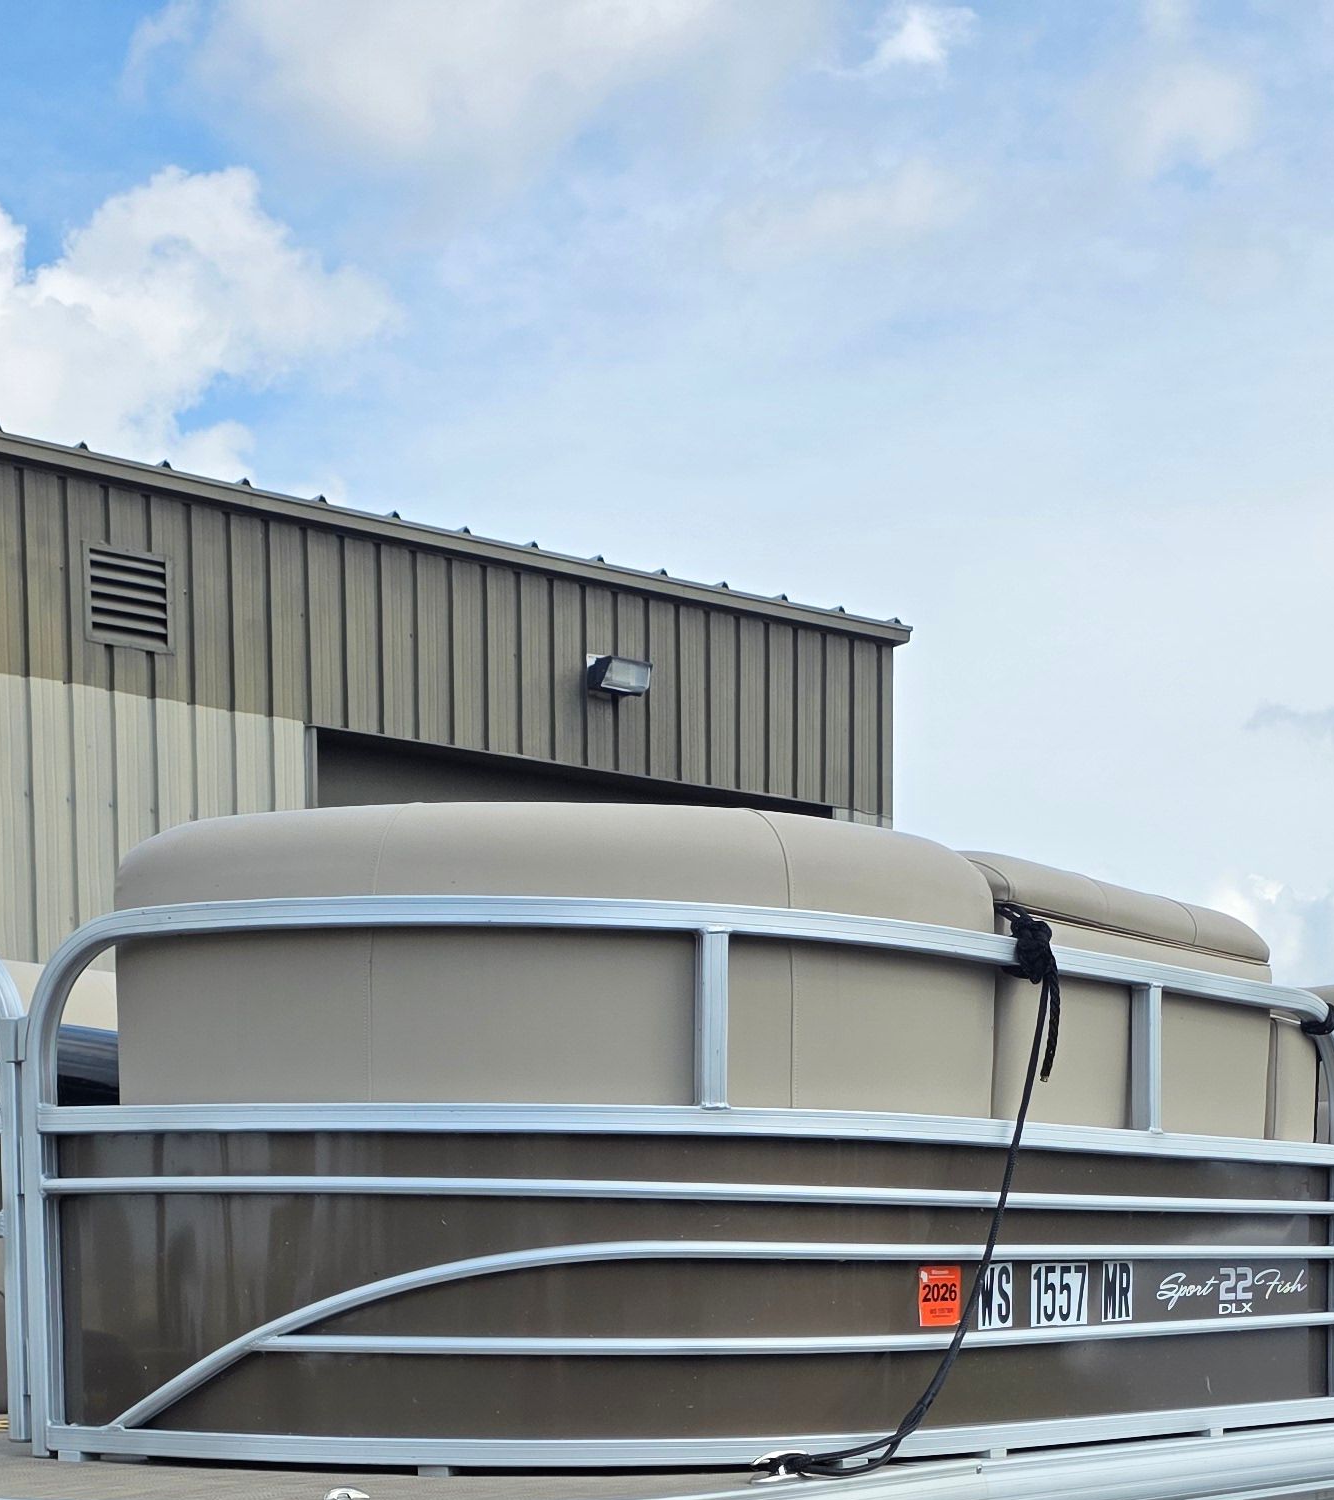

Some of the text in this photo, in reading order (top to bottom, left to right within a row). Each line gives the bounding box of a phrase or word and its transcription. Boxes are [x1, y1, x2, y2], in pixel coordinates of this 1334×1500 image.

[921, 1282, 958, 1303] 2026
[980, 1262, 1131, 1327] WS 1557 MR
[1156, 1266, 1308, 1311] Sport 22 Fish
[1218, 1302, 1253, 1315] DLX
